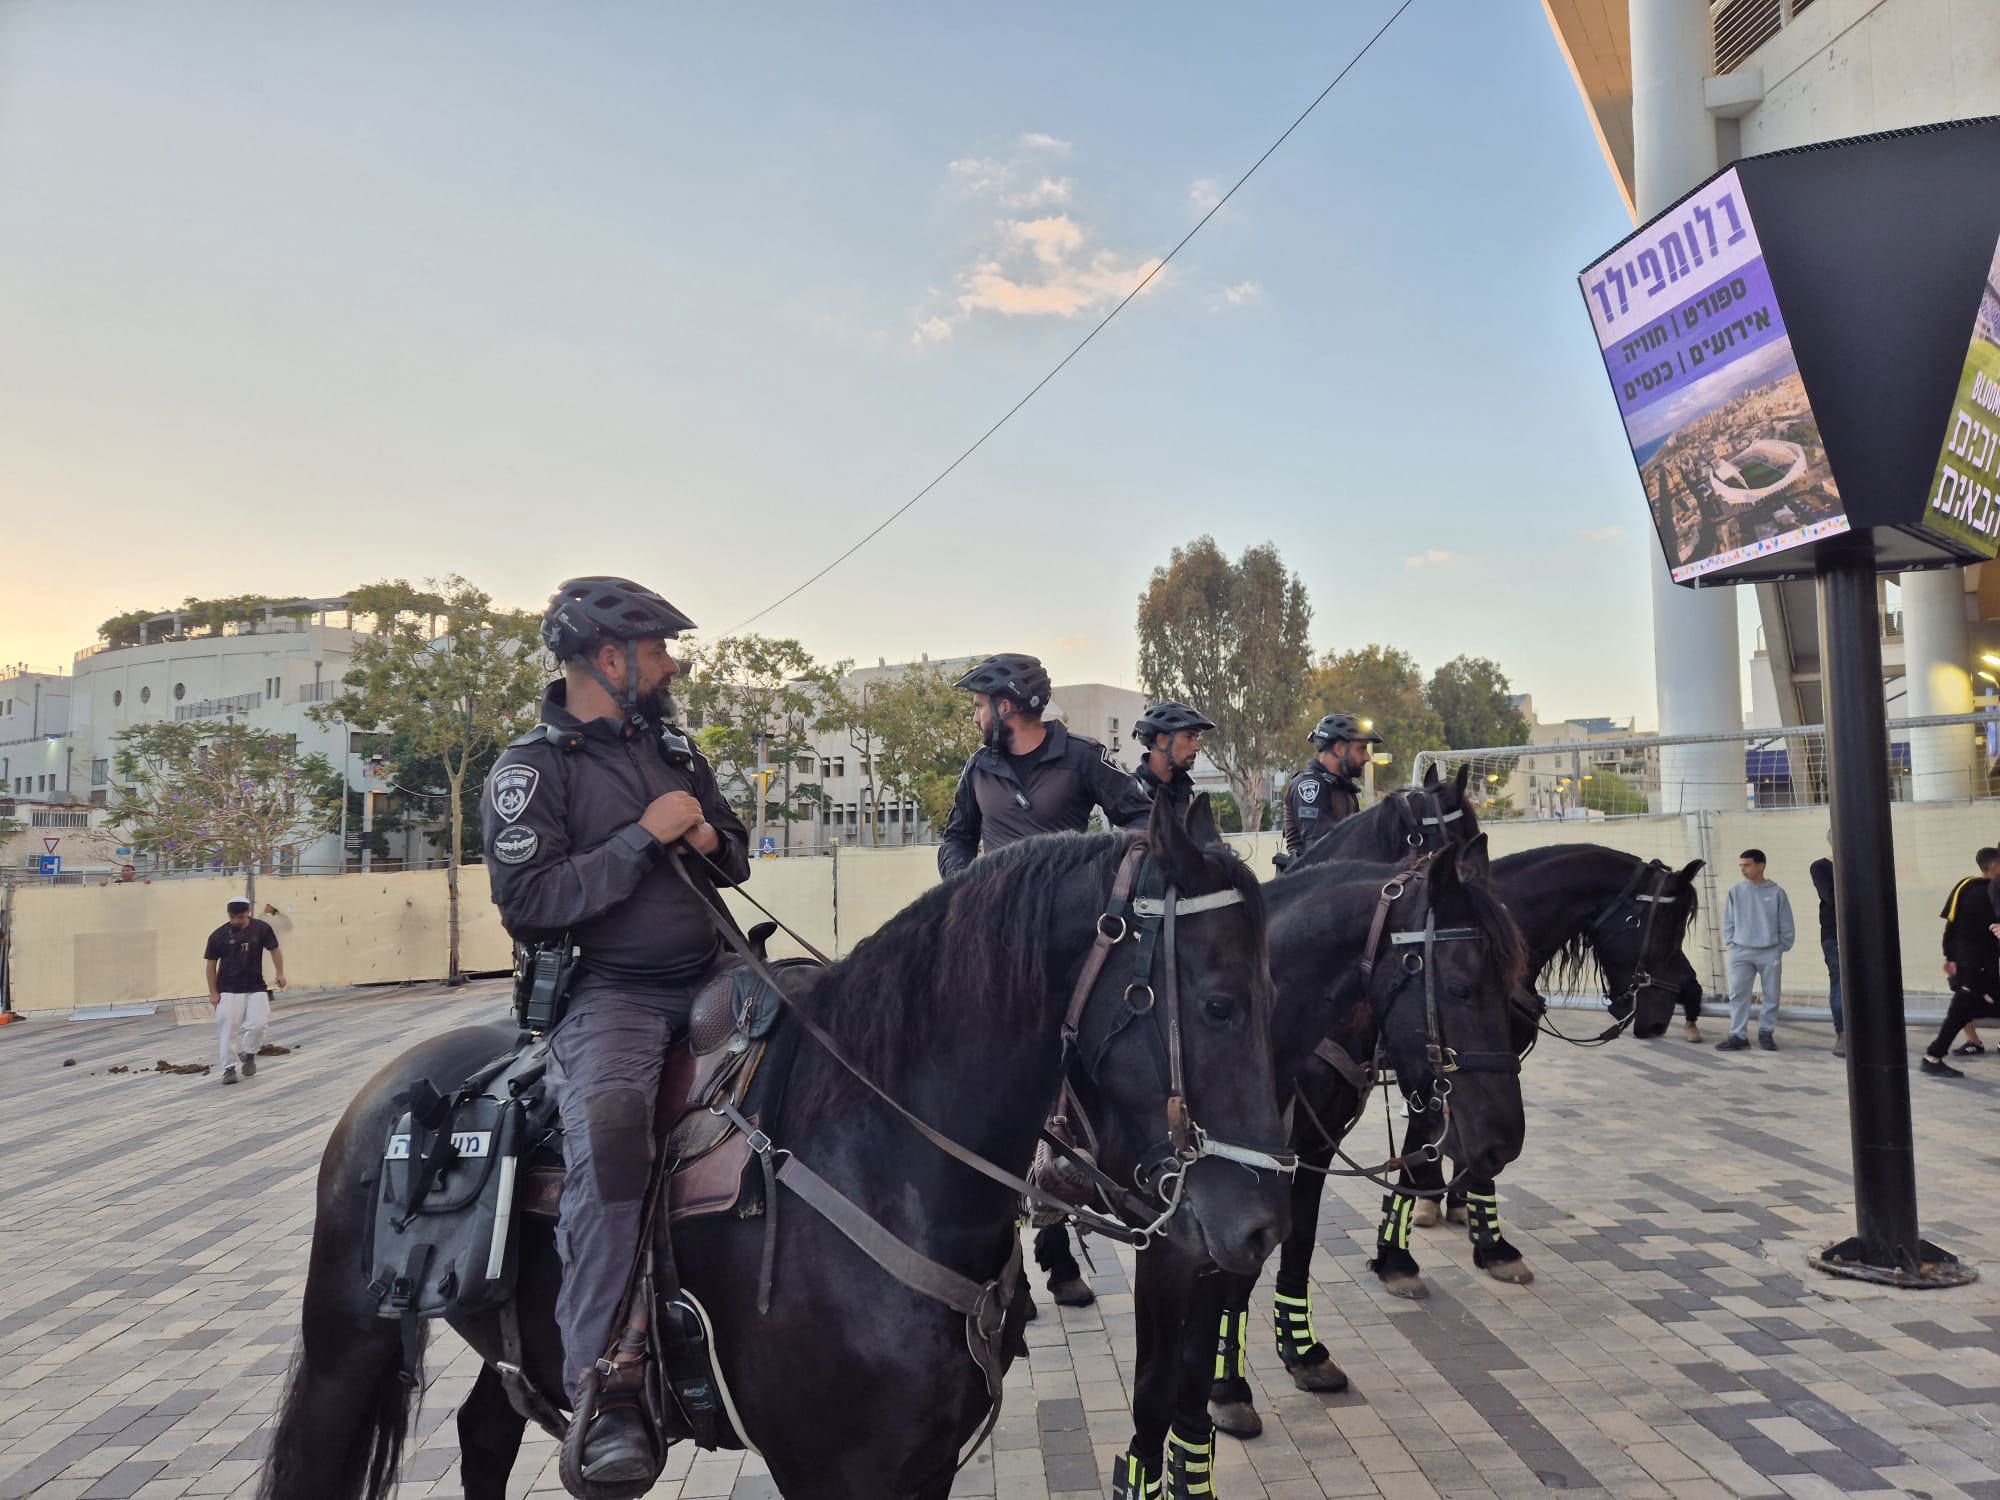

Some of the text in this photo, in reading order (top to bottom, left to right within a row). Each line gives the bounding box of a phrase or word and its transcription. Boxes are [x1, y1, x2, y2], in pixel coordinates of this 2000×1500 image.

[1591, 193, 1747, 324] בלומפילד
[1622, 277, 1747, 363] ספורט חוויה
[1623, 306, 1772, 400] אירועים כנסים
